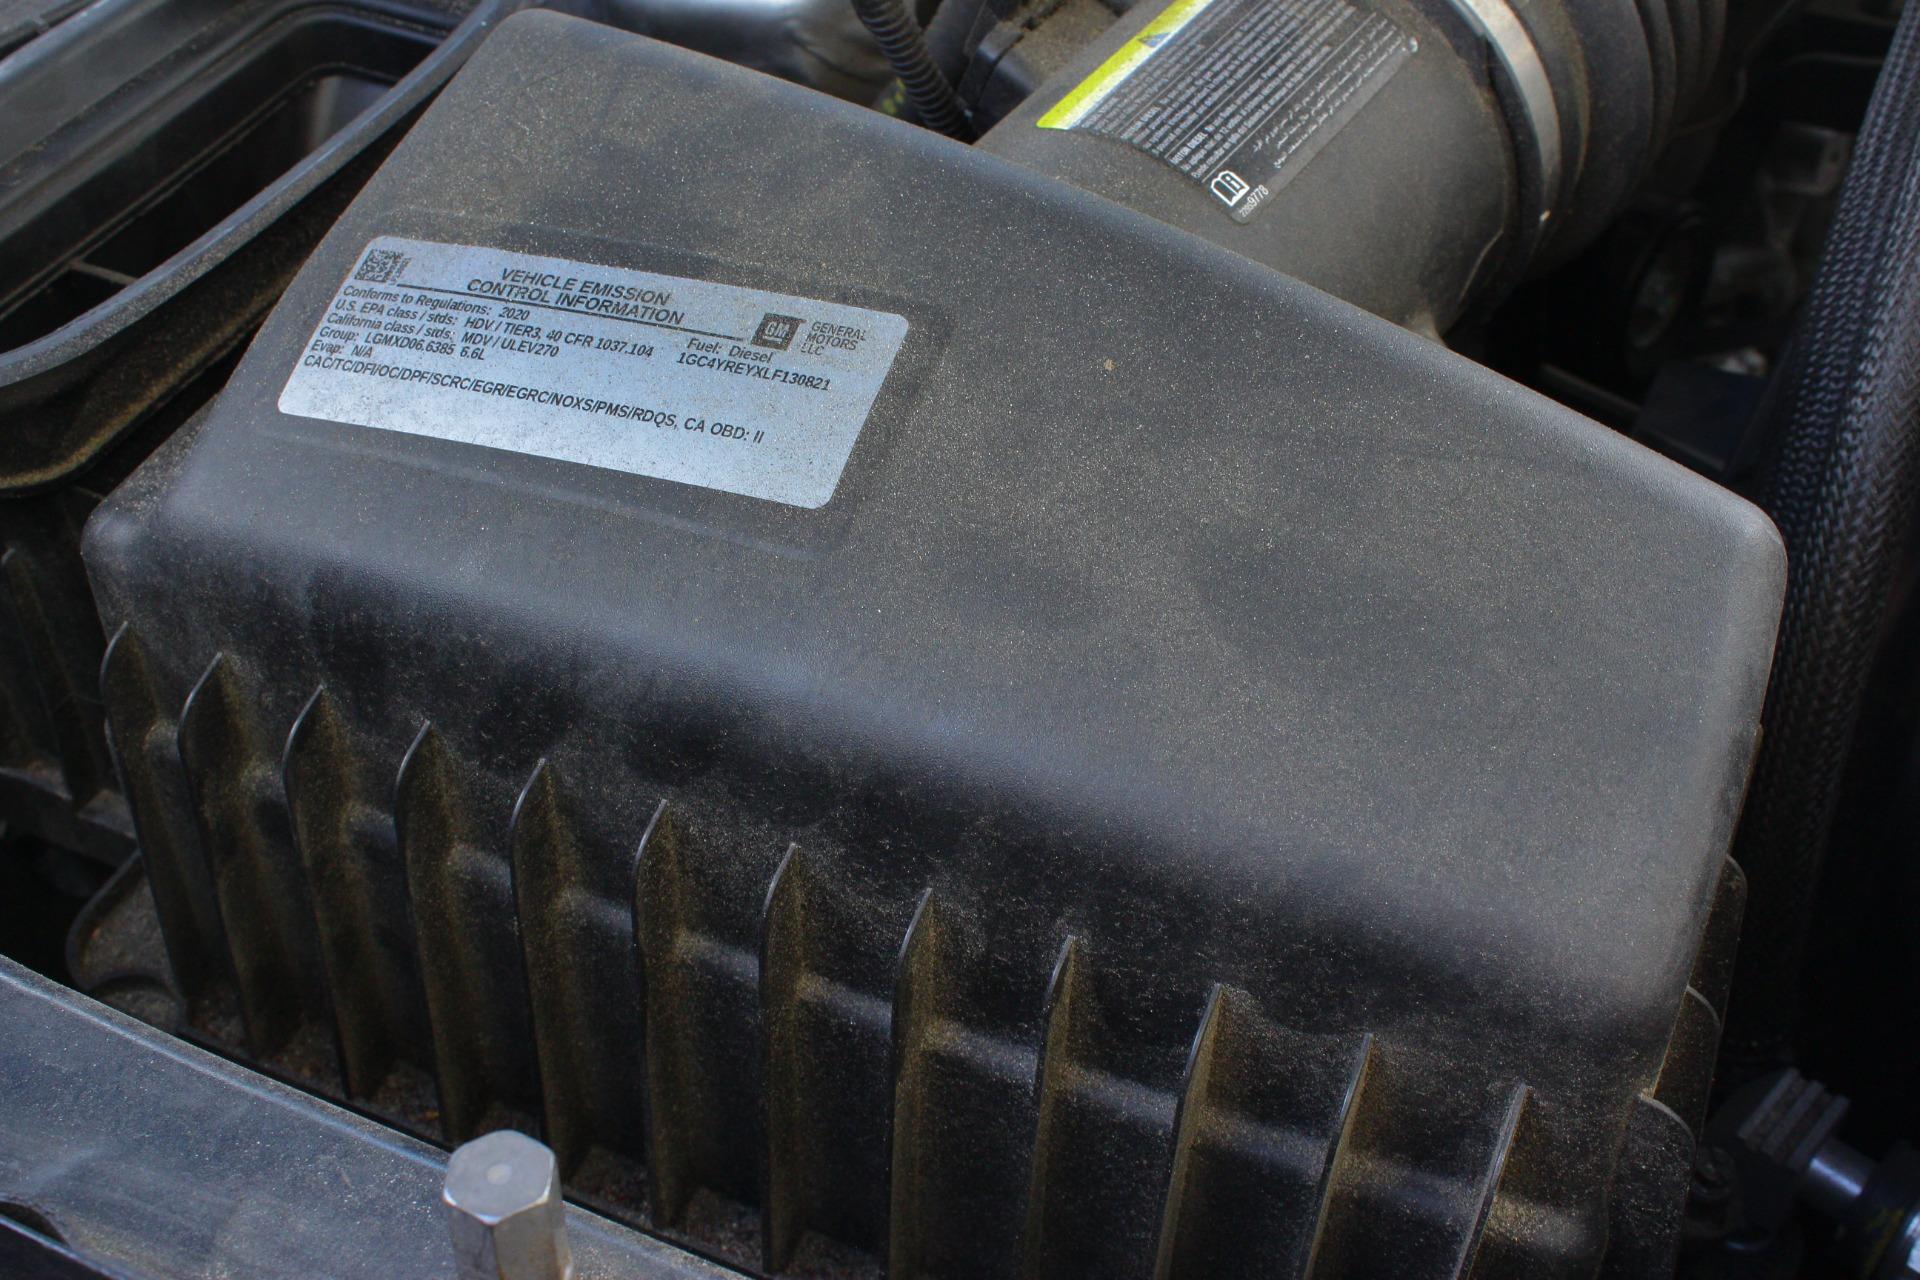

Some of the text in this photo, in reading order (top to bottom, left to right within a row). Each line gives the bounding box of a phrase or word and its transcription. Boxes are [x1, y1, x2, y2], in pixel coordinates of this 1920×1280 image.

[467, 279, 685, 324] CONTROL INFORMATION
[502, 268, 671, 306] VEHICLE EMISSION
[343, 285, 530, 320] Conforms to Regulations: 2020
[319, 326, 485, 360] Group: LGMXD06.6385 6.6L
[327, 312, 559, 357] California class / stds: MDV / ULEV270
[335, 299, 654, 358] U.S. EPA class / stds: HDV / TIER3, 40 CFR 1037.104
[764, 321, 790, 340] GM
[805, 333, 859, 351] MOTORS
[811, 321, 866, 341] GENERAL
[311, 339, 374, 358] Evap: N/A
[687, 337, 774, 364] Fuel: Diesel
[801, 342, 825, 356] LLC
[676, 352, 831, 391] 1GC4YREYXLF130821
[684, 417, 705, 432] CA
[710, 422, 749, 441] OBD:
[753, 430, 765, 444] II
